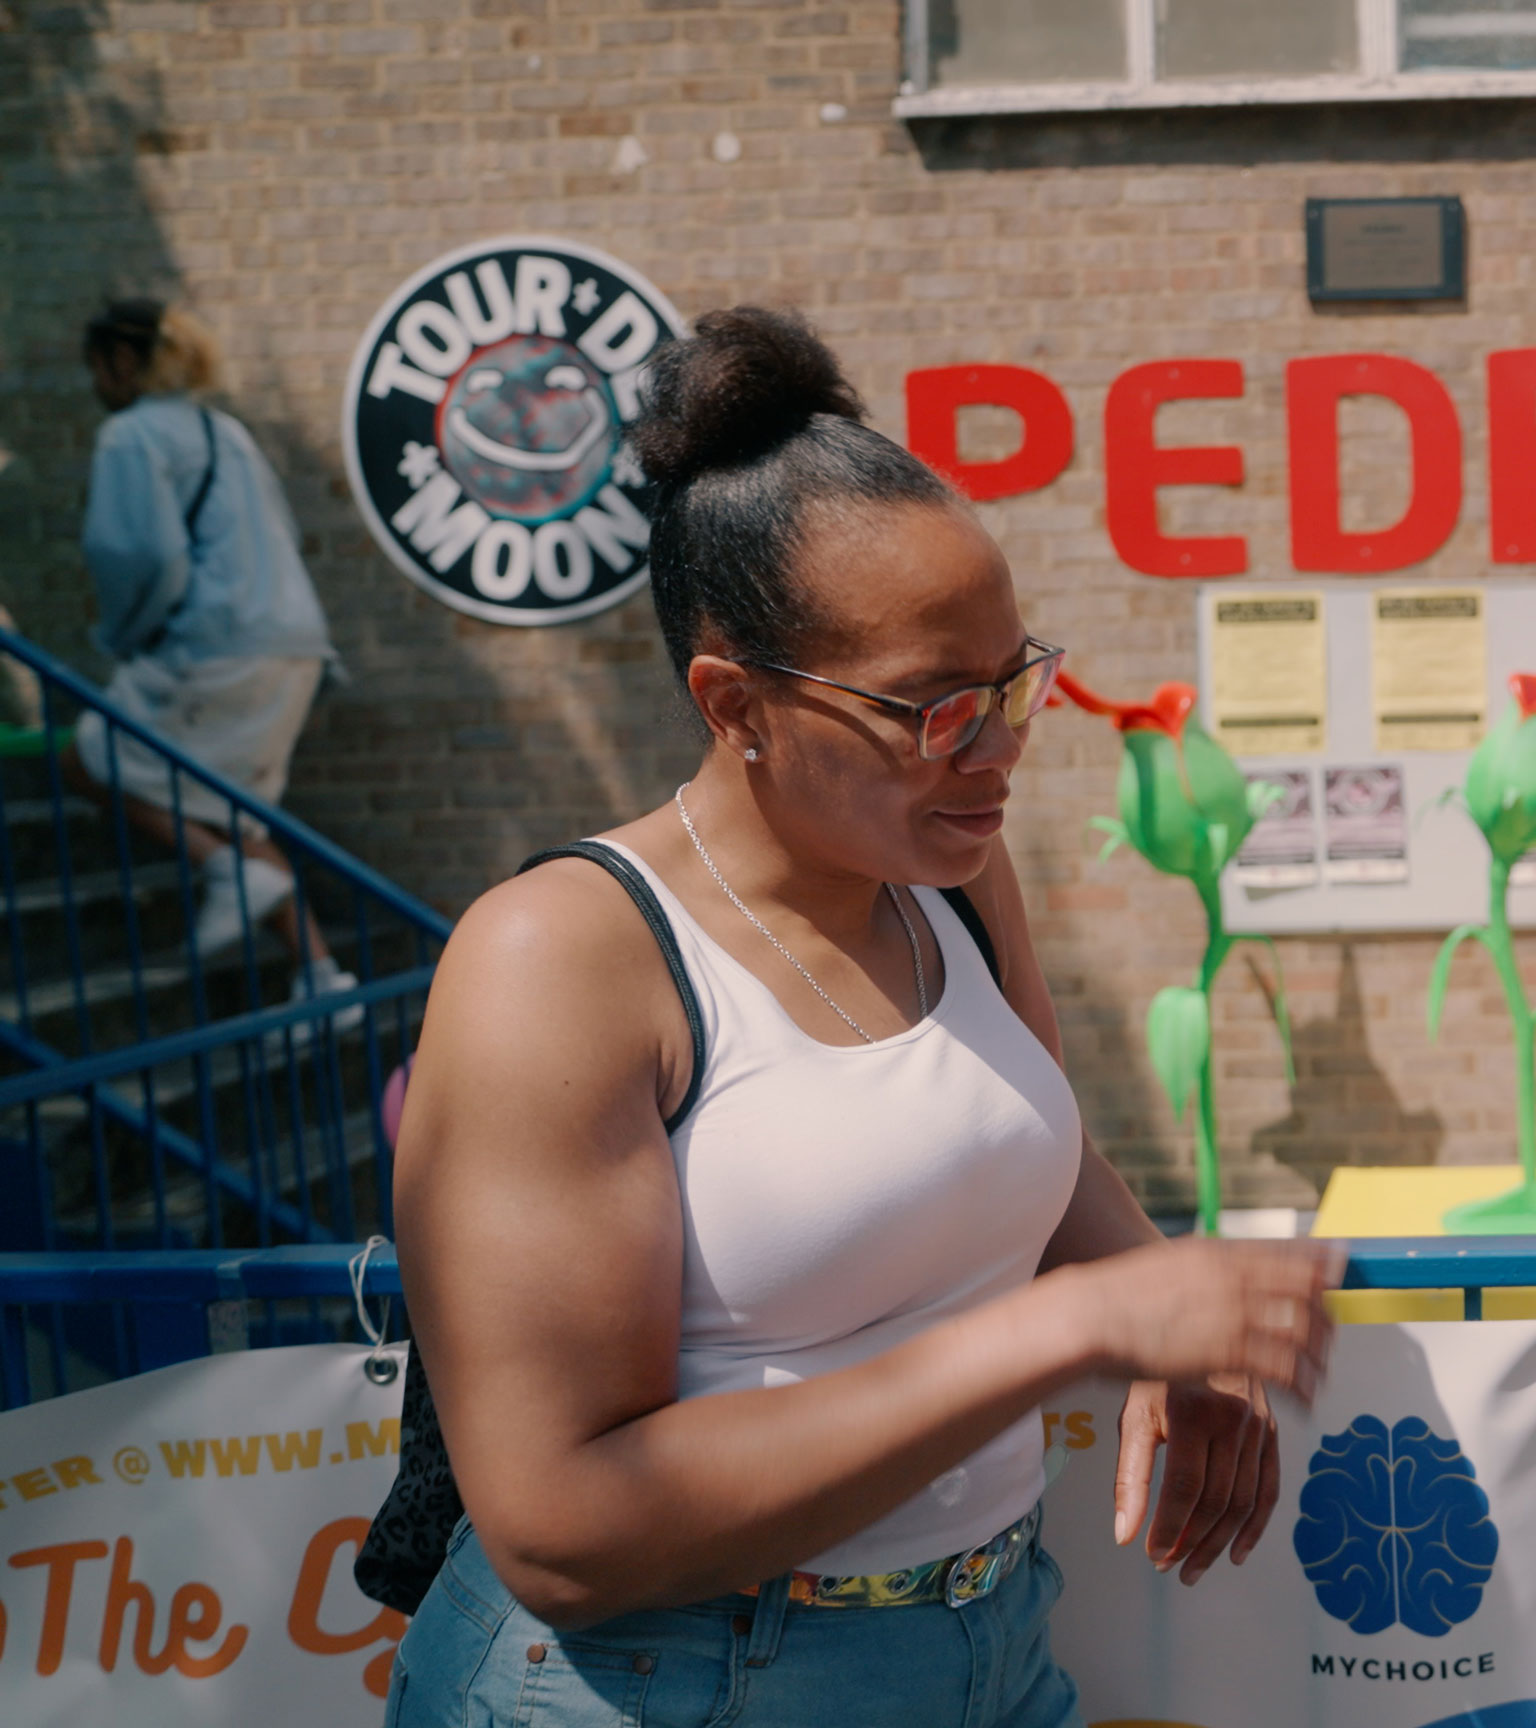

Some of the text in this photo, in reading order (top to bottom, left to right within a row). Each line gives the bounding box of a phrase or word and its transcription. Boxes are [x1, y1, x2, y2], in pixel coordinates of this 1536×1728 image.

[366, 254, 573, 404] TOUR
[391, 467, 651, 600] MOON
[0, 1455, 104, 1511] ER
[113, 1446, 150, 1484] @
[8, 1535, 249, 1679] The
[1311, 1652, 1495, 1681] MYCHOICE
